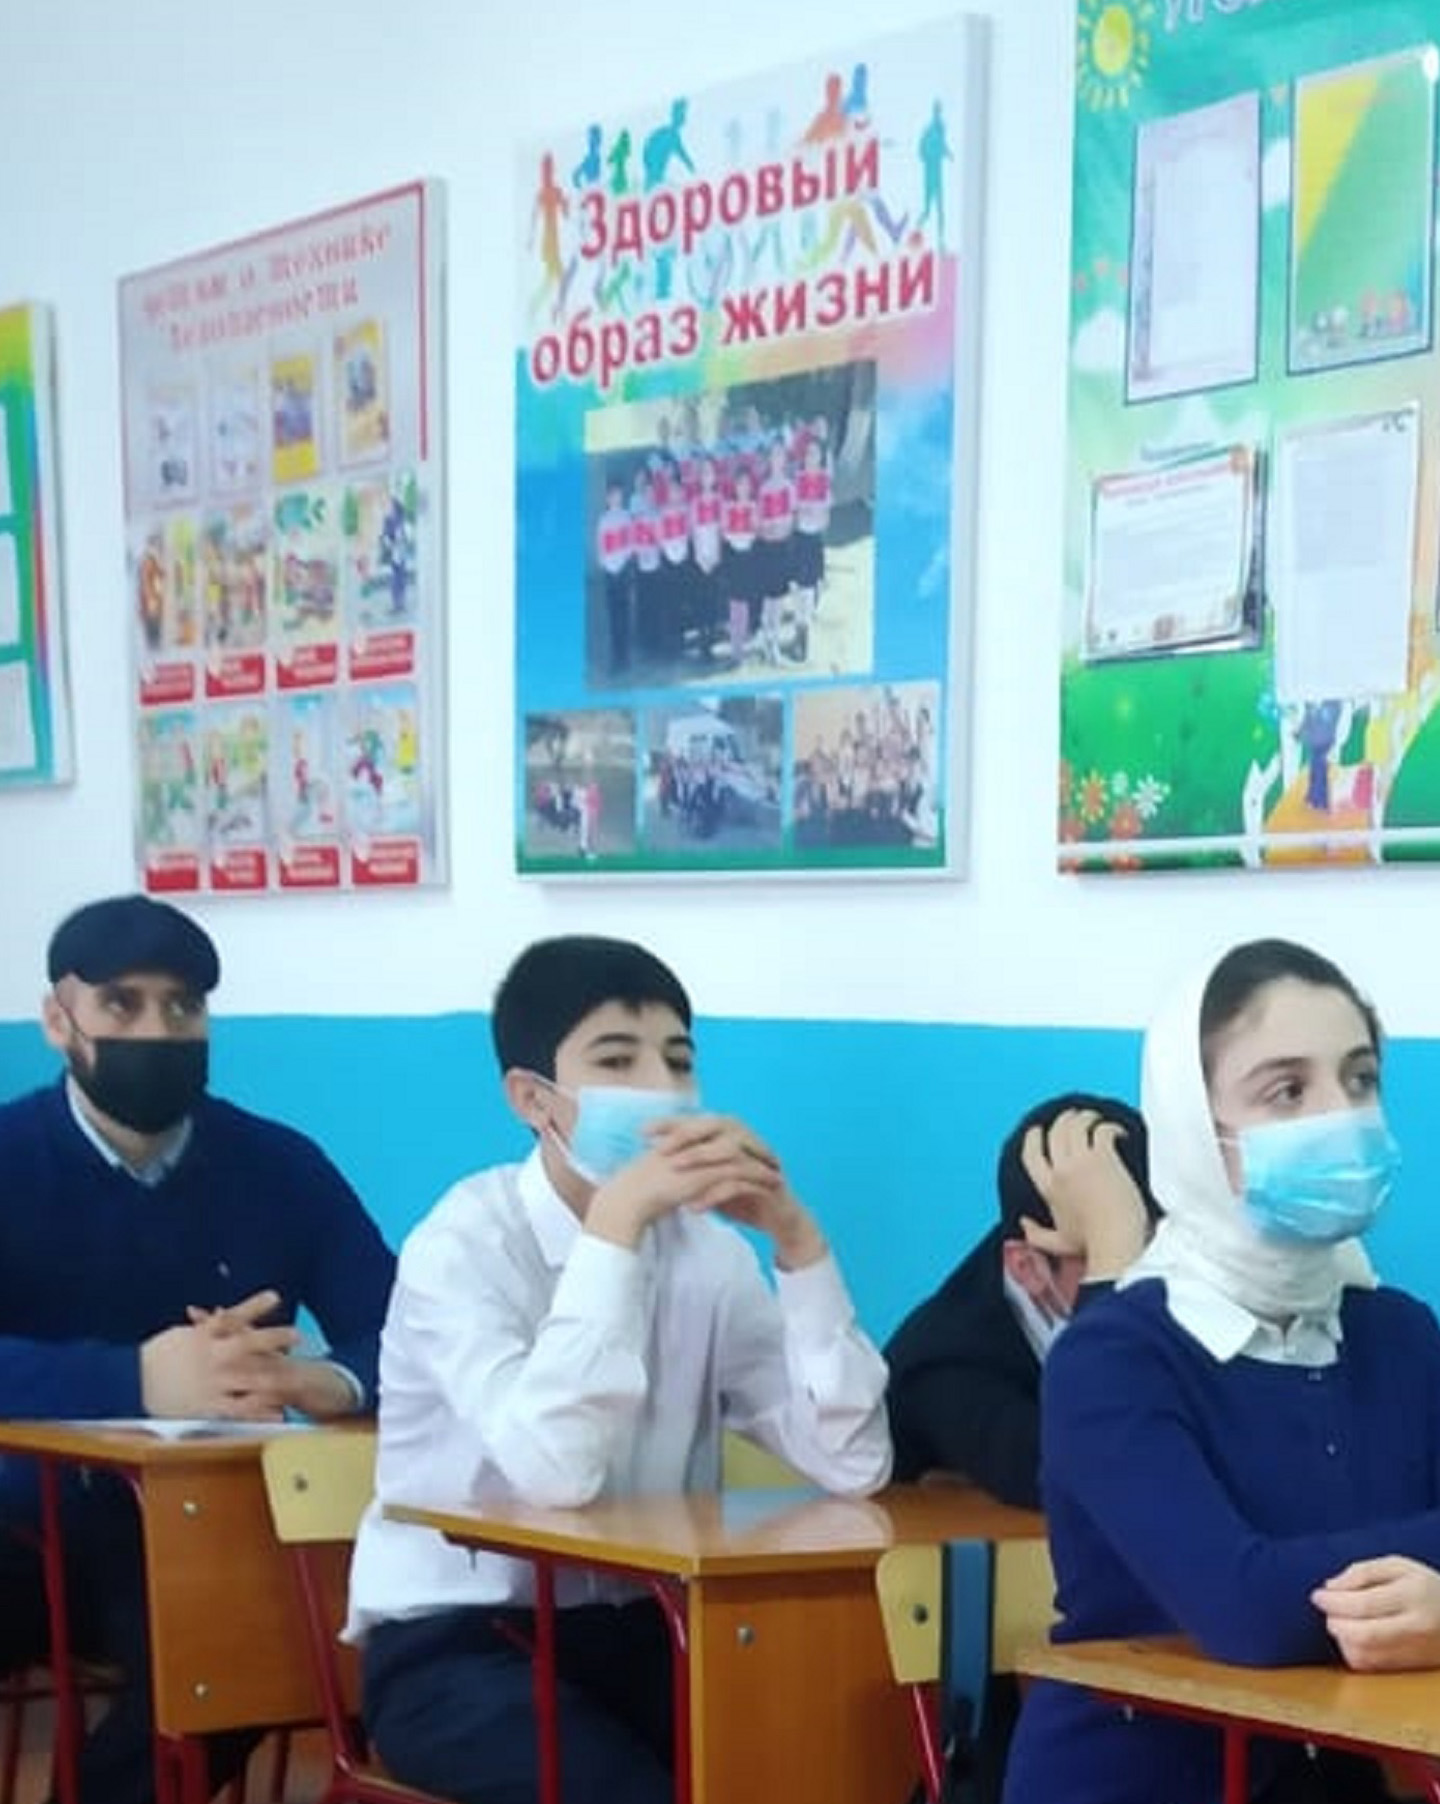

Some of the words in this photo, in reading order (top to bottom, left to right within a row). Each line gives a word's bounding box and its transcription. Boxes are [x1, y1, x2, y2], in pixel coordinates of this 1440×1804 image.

[580, 117, 880, 267] Здоровый
[532, 305, 699, 388] образ
[722, 252, 935, 346] жизни
